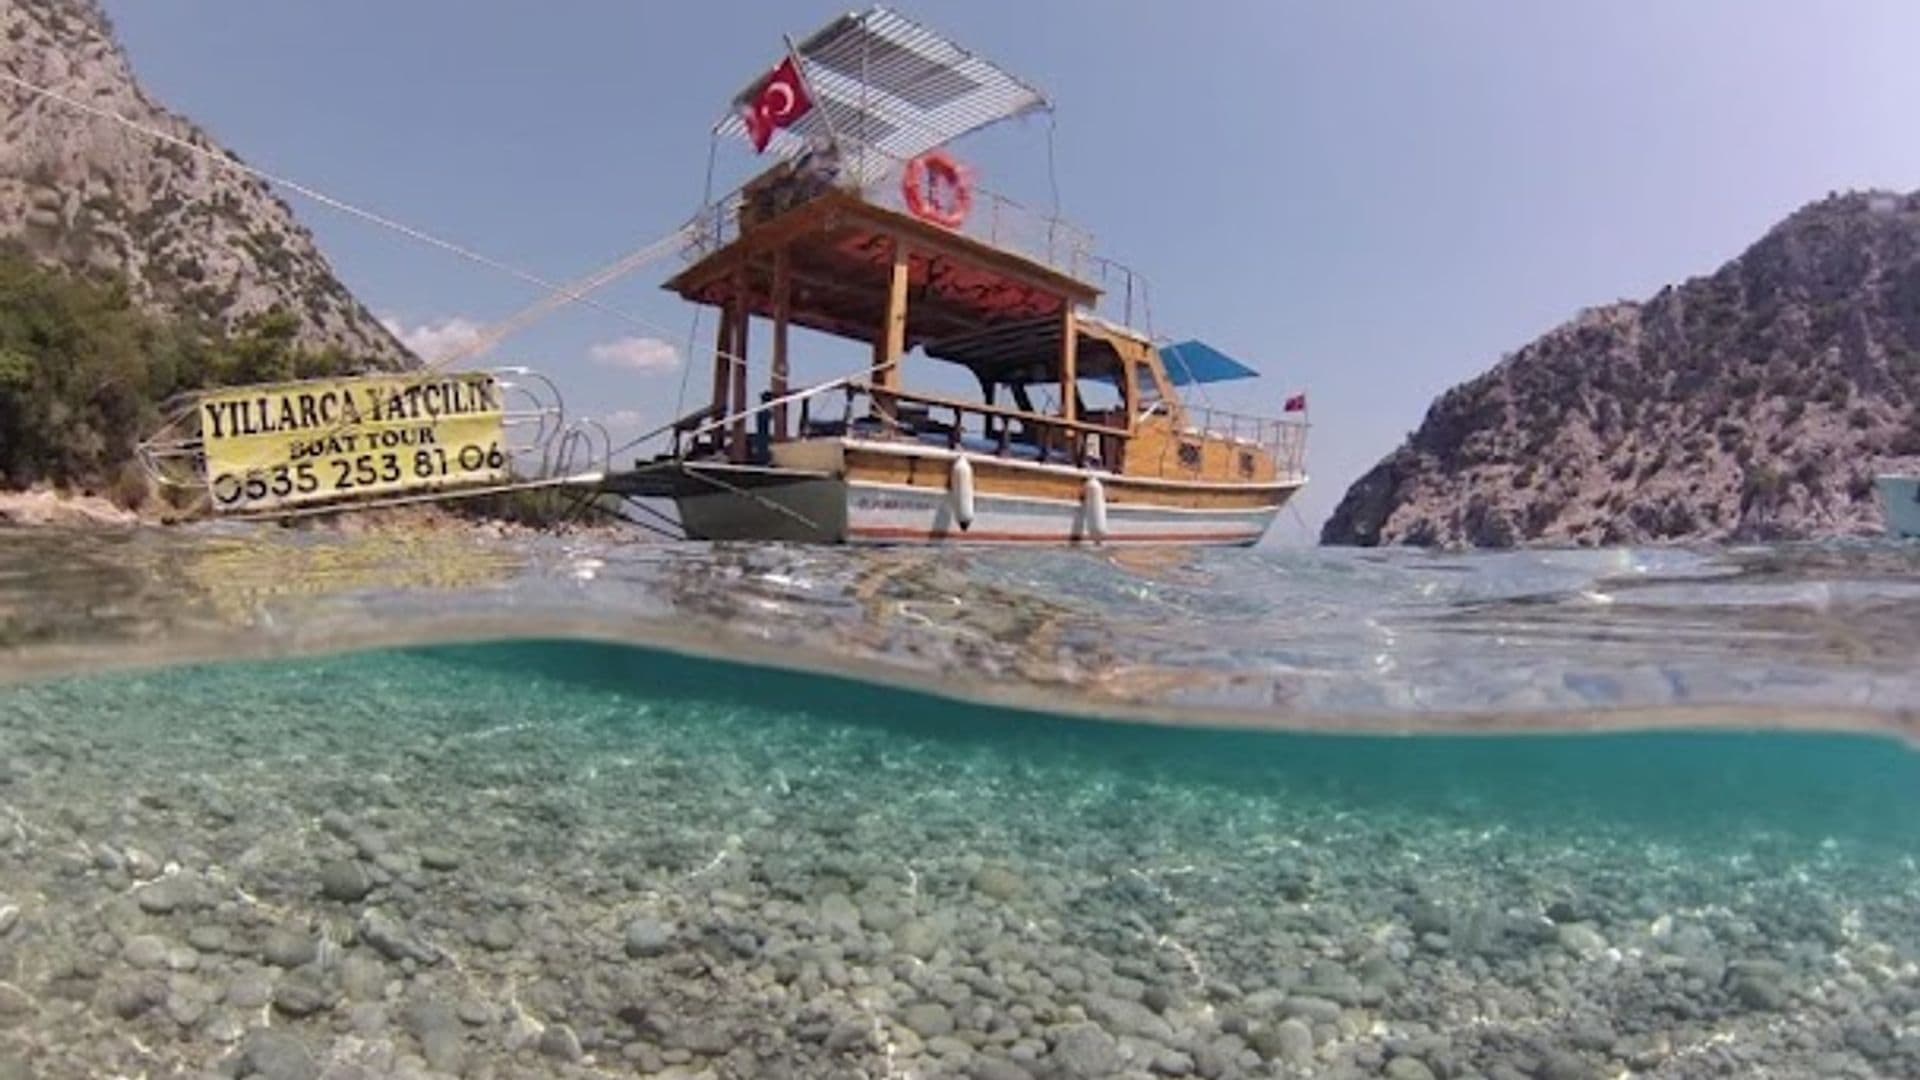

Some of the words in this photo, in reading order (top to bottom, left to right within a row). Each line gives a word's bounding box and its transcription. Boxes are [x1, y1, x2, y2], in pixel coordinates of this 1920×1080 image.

[206, 390, 362, 438] YILLARCA
[290, 436, 358, 460] BOAT
[368, 427, 435, 451] TOUR
[213, 463, 319, 504] 0535
[332, 454, 400, 489] 253
[414, 449, 447, 478] 81
[458, 442, 504, 472] 06
